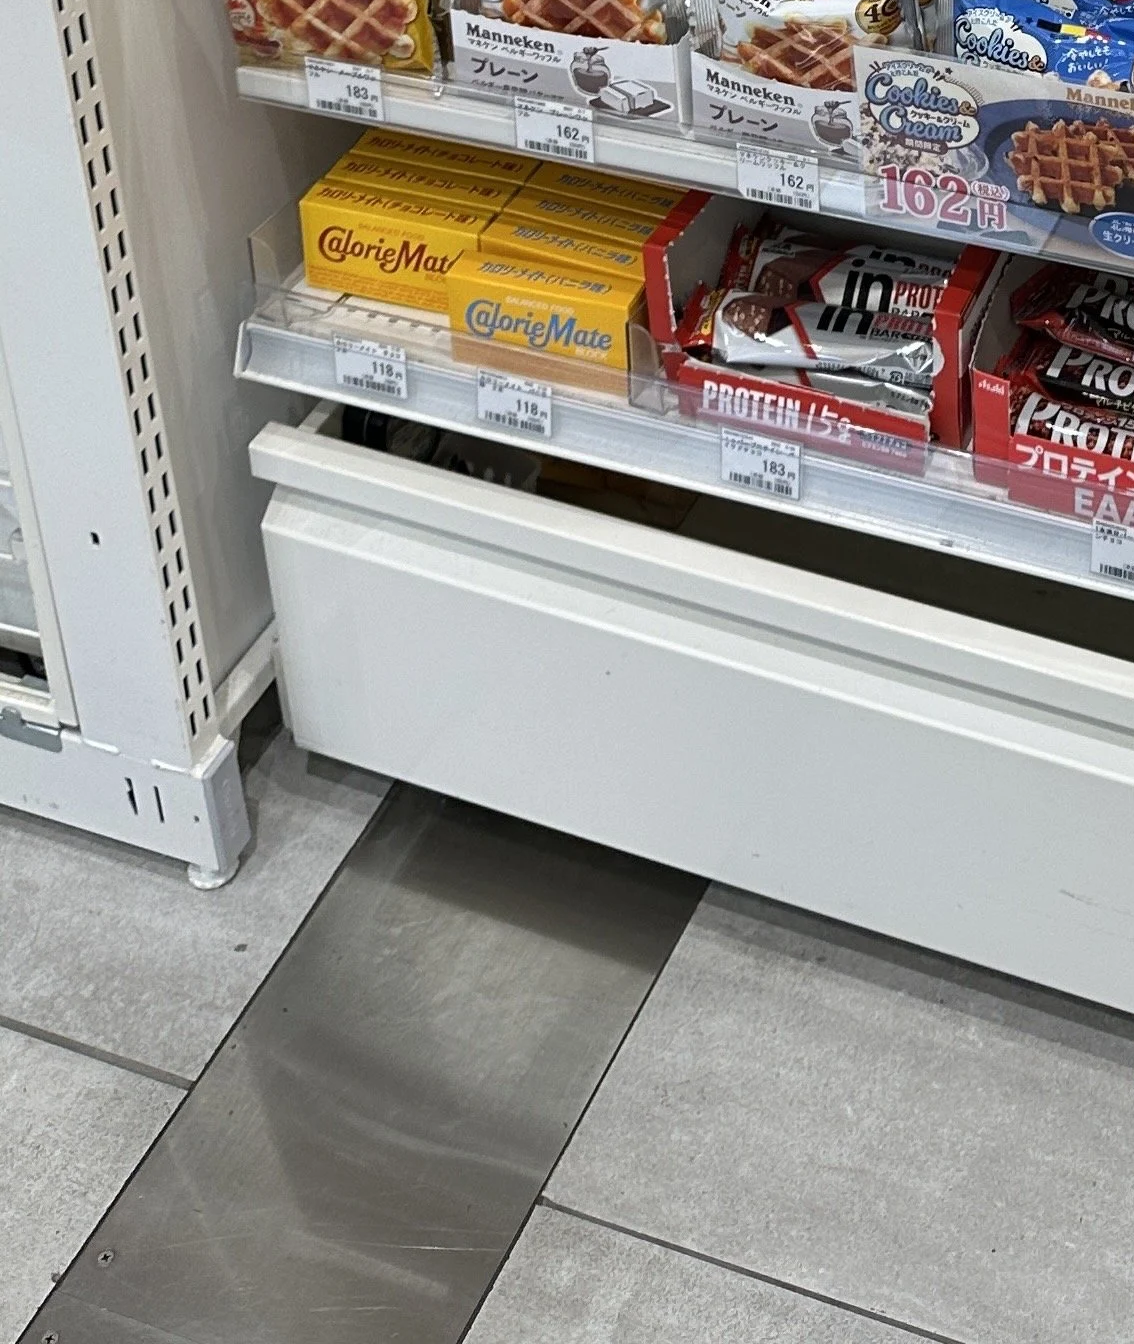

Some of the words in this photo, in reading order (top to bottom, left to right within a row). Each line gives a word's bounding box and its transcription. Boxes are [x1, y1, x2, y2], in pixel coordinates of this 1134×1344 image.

[466, 23, 555, 52] Manneken
[471, 57, 538, 82] プレーン
[882, 108, 963, 141] Cream
[880, 166, 1007, 229] 162円
[465, 300, 612, 349] CalorieMate
[702, 380, 801, 431] PROTEIN
[805, 399, 851, 443] 15g
